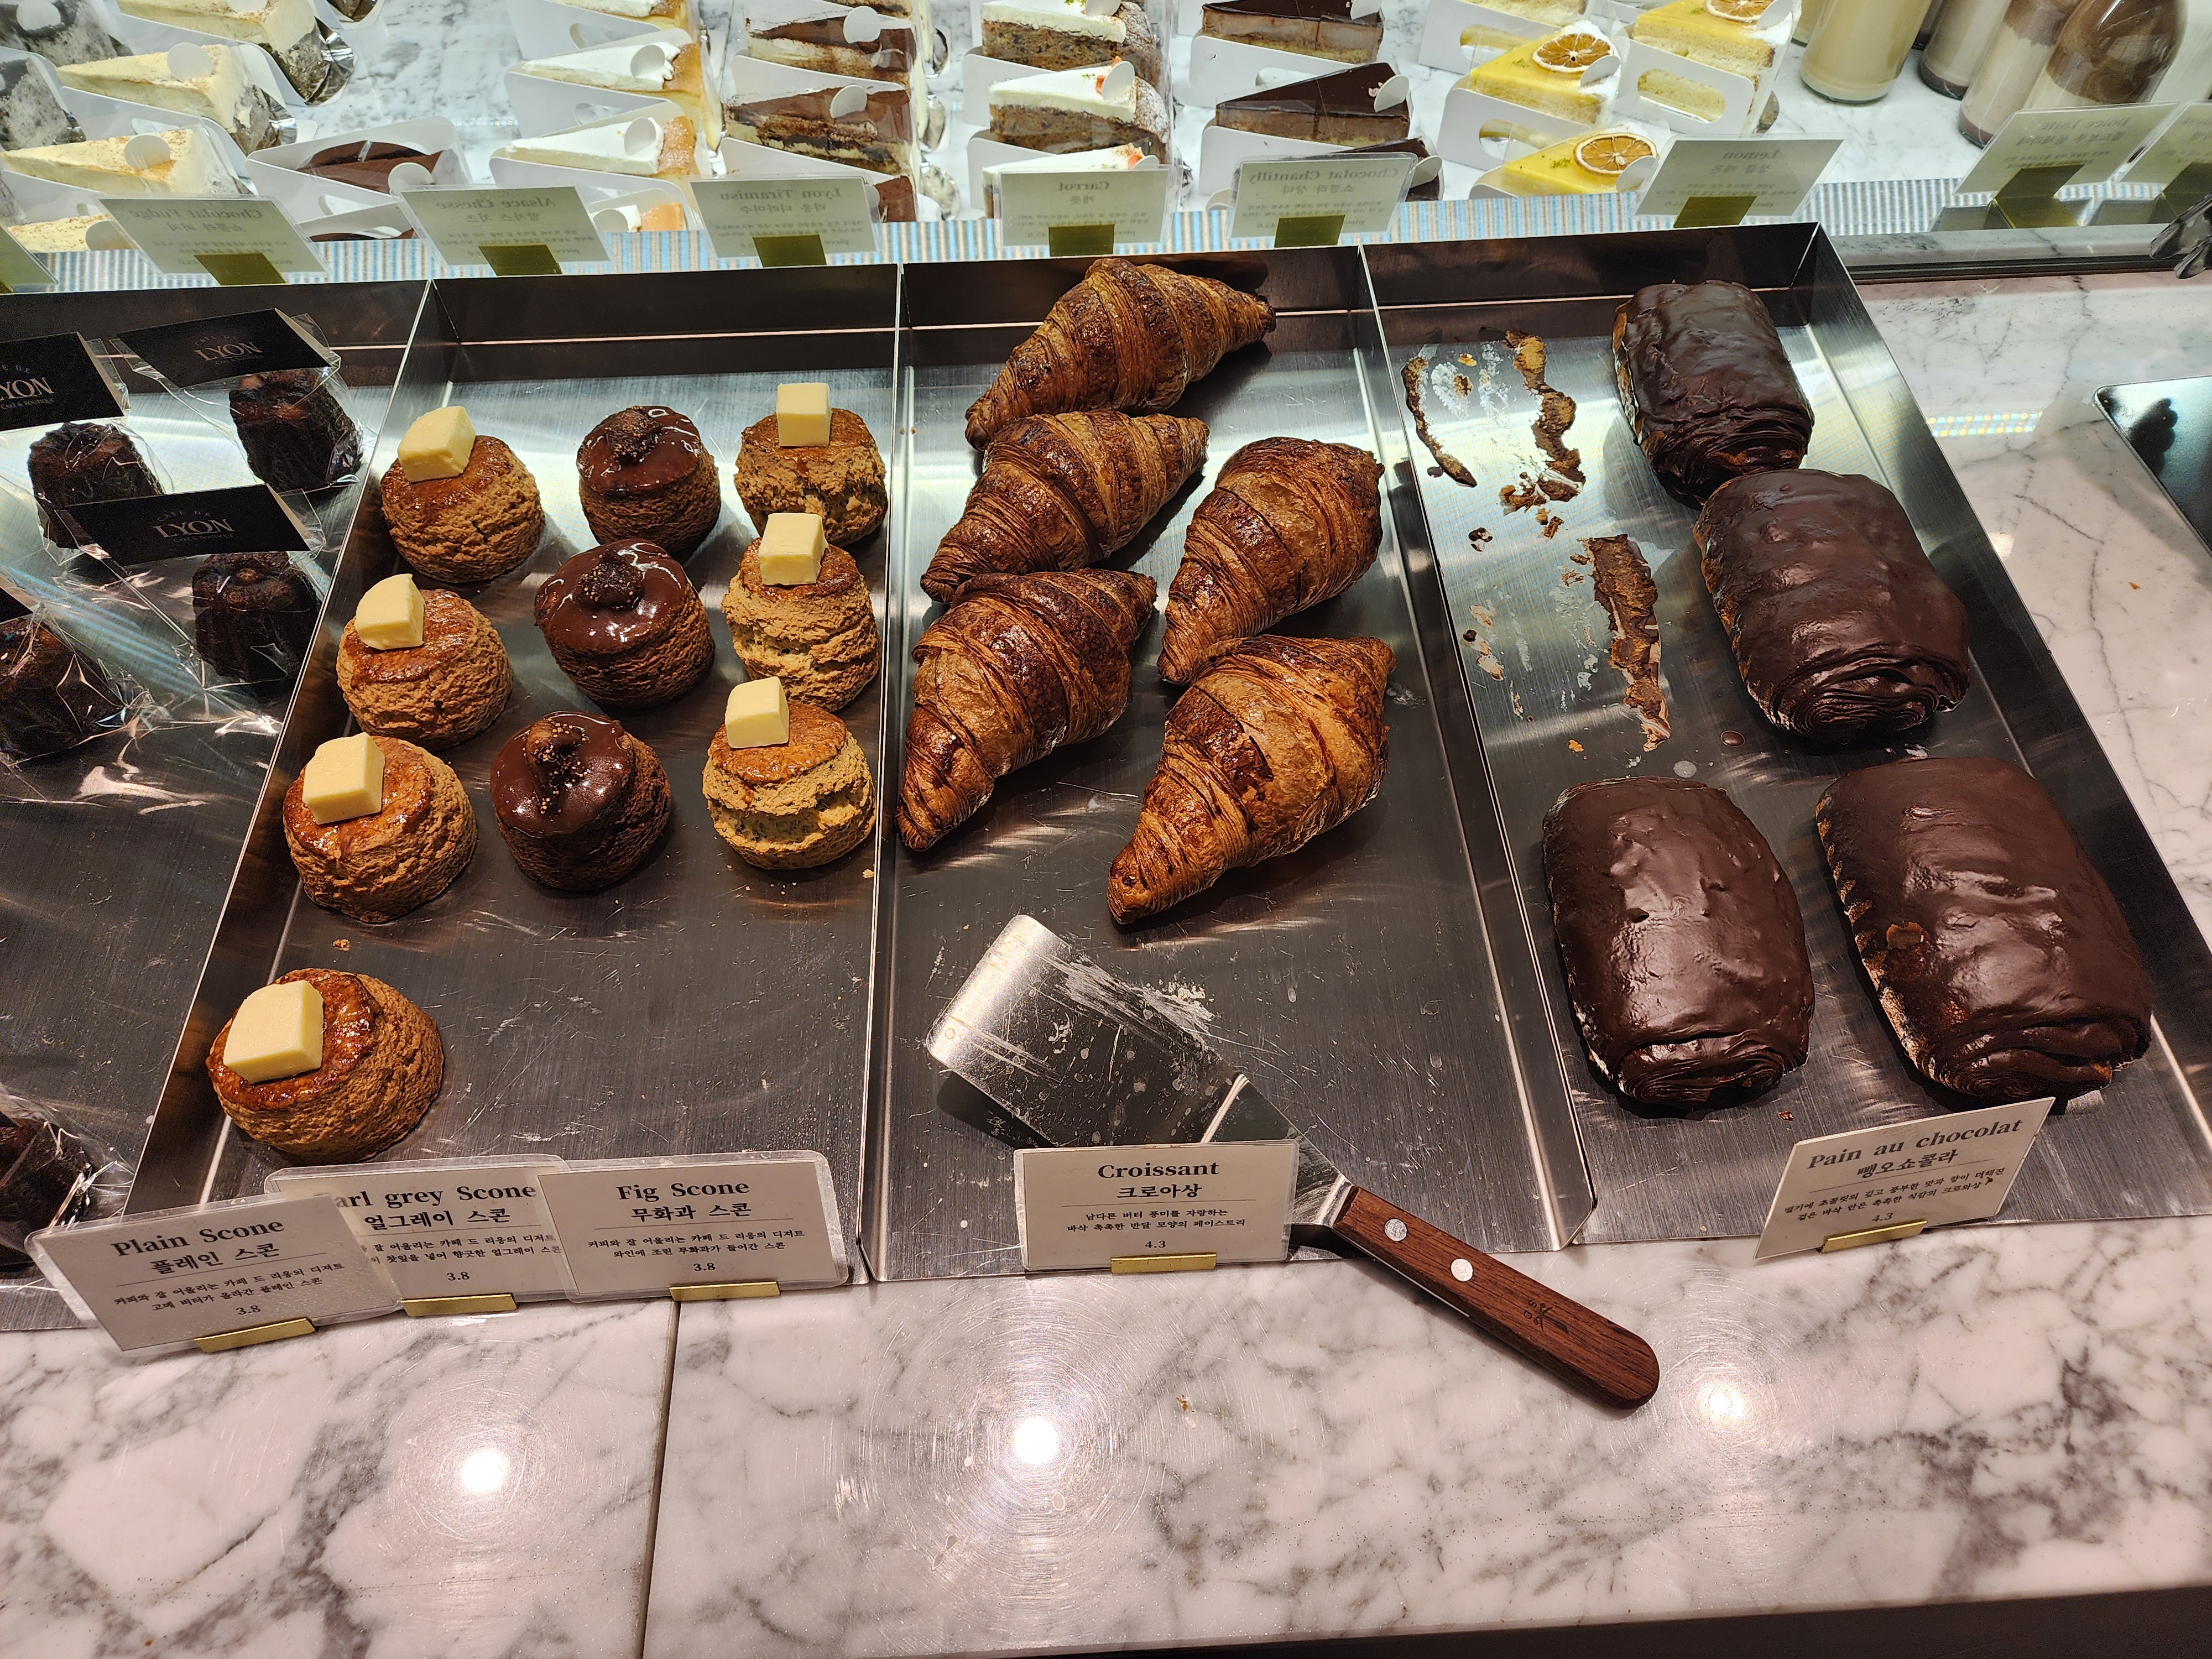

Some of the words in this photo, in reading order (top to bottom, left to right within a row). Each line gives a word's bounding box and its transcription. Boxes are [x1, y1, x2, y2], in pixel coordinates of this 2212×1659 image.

[194, 342, 264, 361] LYON
[0, 377, 55, 401] YON
[153, 519, 236, 538] LYON
[1807, 1149, 1861, 1170] Pain
[1874, 1141, 1903, 1156] au
[1916, 1119, 2023, 1149] chocolat
[1098, 1162, 1219, 1178] Croissant
[1857, 1149, 1958, 1178] 뺑오쇼콜라
[1889, 1182, 1920, 1193] 풍부한
[1925, 1177, 1944, 1187] 맛과
[1950, 1173, 1970, 1182] 향이
[1975, 1167, 2005, 1178] 더해진
[333, 1191, 373, 1208] arl
[385, 1189, 444, 1209] grey
[457, 1186, 537, 1202] Scone
[615, 1185, 659, 1202] Fig
[670, 1182, 750, 1197] Scone
[1117, 1183, 1202, 1198] 크로아상
[1822, 1206, 1843, 1215] 바삭
[1848, 1202, 1867, 1212] 안은
[1908, 1188, 1937, 1199] 식감의
[364, 1210, 453, 1230] 얼그레이
[467, 1208, 510, 1223] 스콘
[631, 1204, 696, 1222] 무화과
[708, 1203, 752, 1217] 스콘
[1086, 1212, 1117, 1220] 남다른
[1123, 1211, 1142, 1219] 버터
[1149, 1209, 1181, 1218] 풍미를
[1186, 1209, 1228, 1217] 자랑하는
[1872, 1212, 1893, 1223] 4.3
[1067, 1224, 1088, 1232] 바삭
[1093, 1223, 1125, 1231] 촉촉한
[1130, 1221, 1151, 1229] 반달
[1156, 1220, 1187, 1228] 모양의
[1193, 1219, 1245, 1227] 페이스트리
[111, 1235, 190, 1257] Plain
[199, 1221, 284, 1243] Scone
[374, 1244, 384, 1252] 잘
[390, 1240, 435, 1251] 어울리는
[440, 1239, 462, 1248] 카페
[484, 1235, 517, 1245] 리옹의
[587, 1239, 620, 1249] 커피와
[643, 1235, 686, 1245] 어울리는
[691, 1234, 712, 1243] 카페
[718, 1233, 730, 1241] 드
[735, 1230, 766, 1240] 리옹의
[1144, 1240, 1166, 1249] 4.3
[150, 1251, 223, 1274] 플레인
[235, 1243, 280, 1260] 스콘
[425, 1251, 447, 1261] 넣어
[452, 1249, 486, 1259] 향긋한
[491, 1246, 535, 1256] 얼그레이
[613, 1249, 645, 1259] 와인에
[651, 1246, 674, 1256] 조린
[678, 1244, 721, 1254] 무화과가
[726, 1243, 759, 1253] 들어간
[764, 1241, 786, 1250] 스콘
[446, 1271, 470, 1282] 3.8
[692, 1262, 716, 1272] 3.8
[114, 1294, 149, 1305] 커피와
[154, 1290, 167, 1298] 잘
[173, 1284, 219, 1296] 어울리는
[224, 1277, 248, 1287] 카페
[270, 1269, 305, 1280] 리옹의
[180, 1295, 215, 1306] 버터가
[220, 1288, 254, 1300] 올라간
[260, 1281, 295, 1293] 플레인
[300, 1277, 322, 1286] 스콘
[236, 1305, 261, 1316] 3.8
